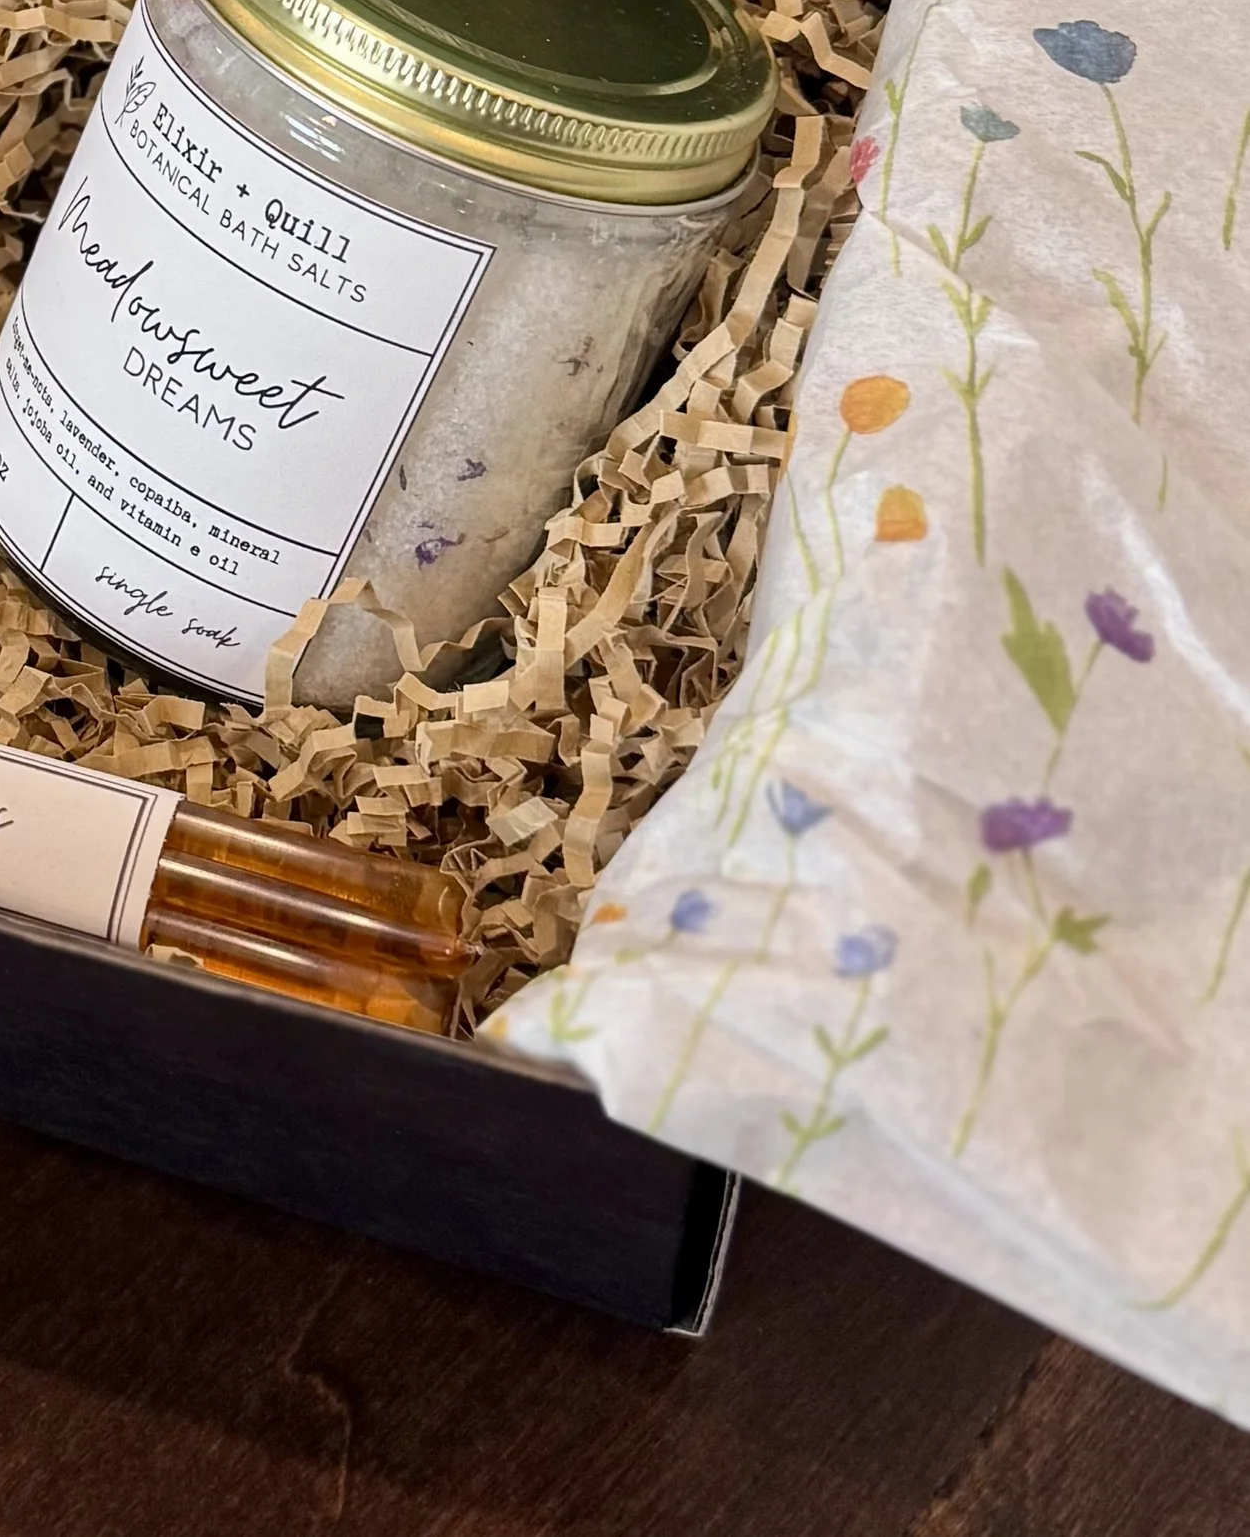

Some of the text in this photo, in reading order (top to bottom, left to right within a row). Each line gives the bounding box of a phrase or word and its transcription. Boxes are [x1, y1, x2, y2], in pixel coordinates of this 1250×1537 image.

[129, 118, 368, 304] BOTANICAL BATH SALTS
[152, 102, 351, 264] Elixir + Quill
[58, 175, 346, 429] Meadowsweet
[122, 346, 257, 452] DREAMS
[22, 398, 52, 444] jojoba
[56, 443, 80, 475] oil,
[87, 474, 115, 501] and
[120, 499, 182, 548] vitamin
[190, 545, 201, 557] e
[209, 555, 239, 576] oil
[59, 410, 120, 477] lavender,
[129, 475, 198, 528] copaiba,
[208, 524, 281, 566] mineral
[95, 566, 241, 649] single soak
